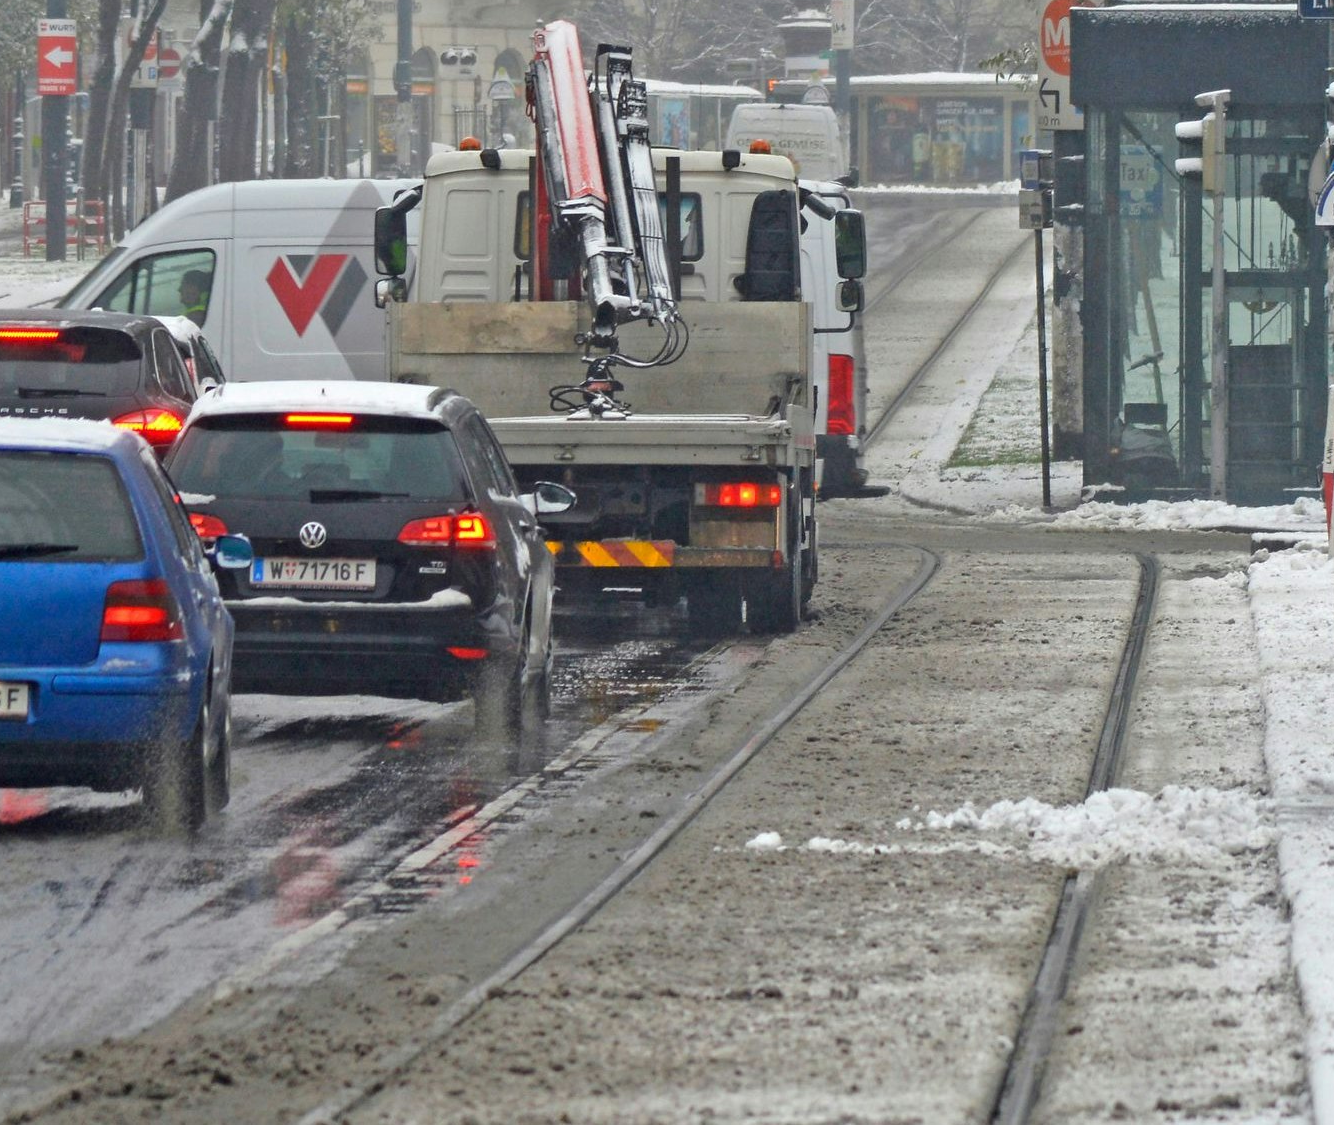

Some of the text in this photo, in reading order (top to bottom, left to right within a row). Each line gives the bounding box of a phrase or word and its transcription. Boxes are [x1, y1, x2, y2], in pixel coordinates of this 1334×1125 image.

[270, 562, 367, 581] W 71716 F
[7, 688, 20, 709] F
